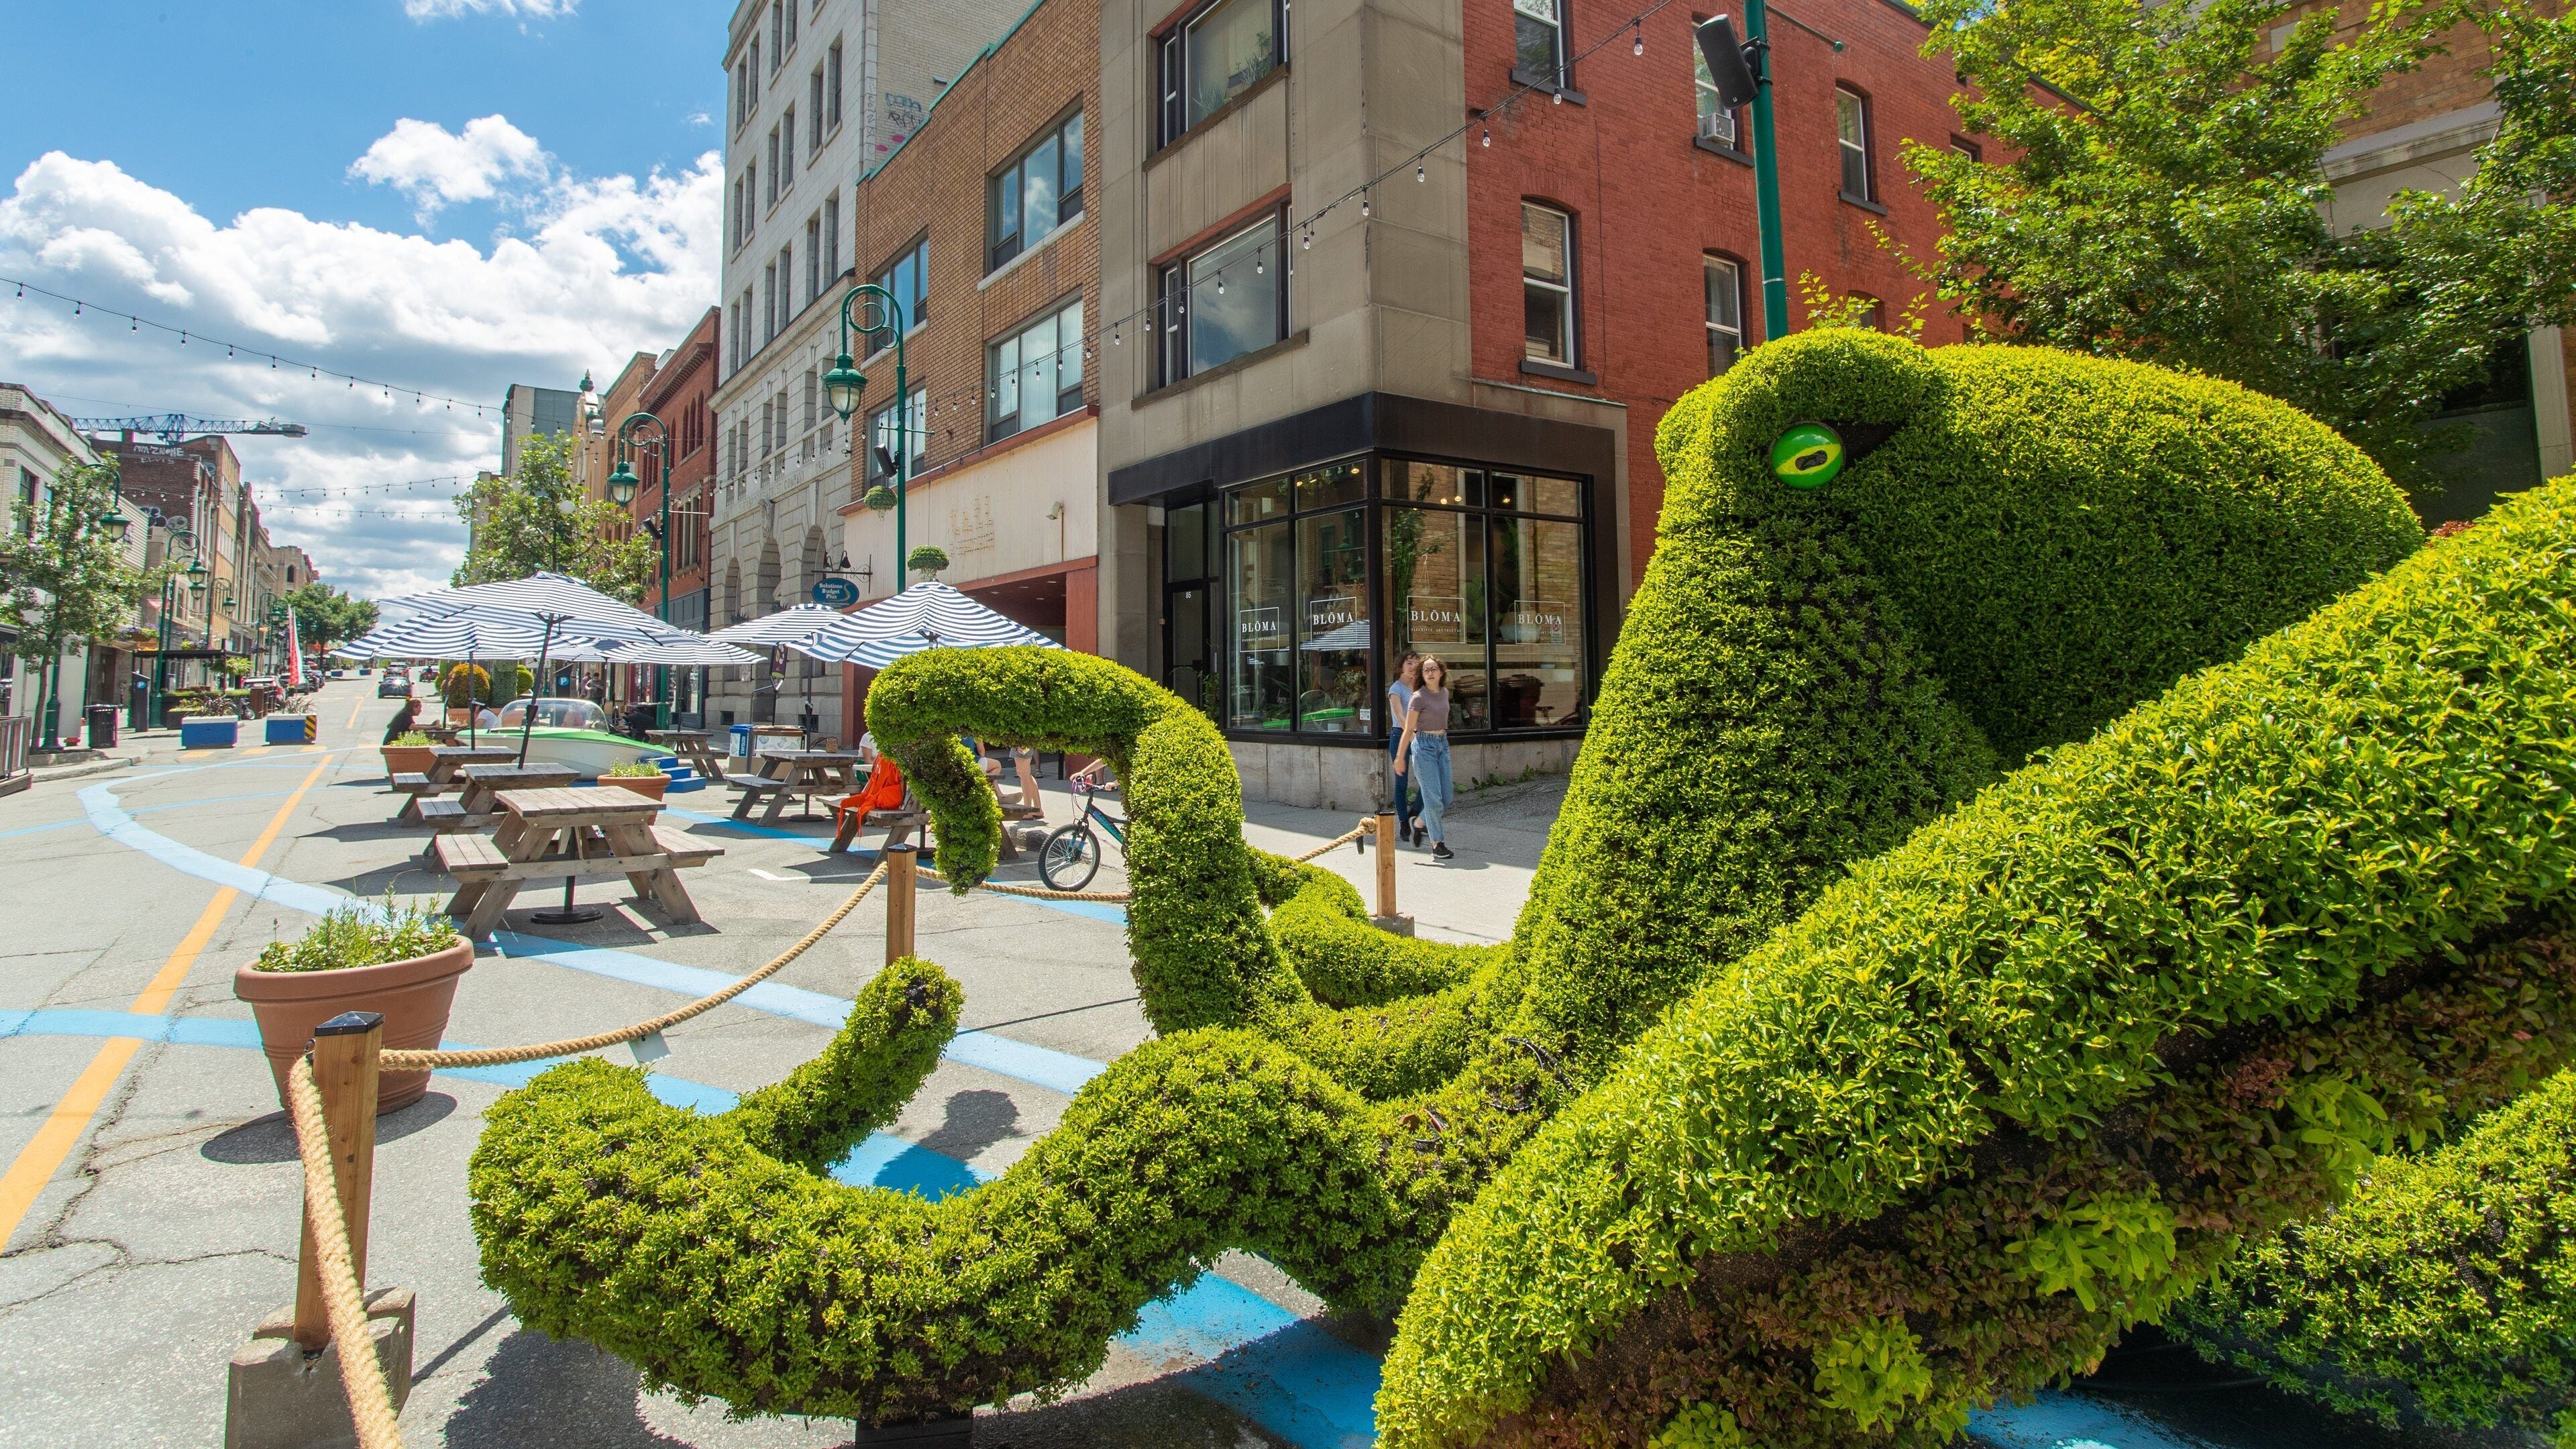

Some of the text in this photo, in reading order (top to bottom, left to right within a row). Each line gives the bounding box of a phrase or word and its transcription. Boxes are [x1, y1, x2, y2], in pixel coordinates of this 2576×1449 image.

[784, 472, 804, 490] COMPANY
[1185, 591, 1191, 599] 85
[1313, 612, 1354, 625] BLŌMA
[1411, 610, 1461, 623] BLŌMA
[1518, 613, 1562, 625] BLŌMA
[1242, 621, 1277, 633] BLŌMA
